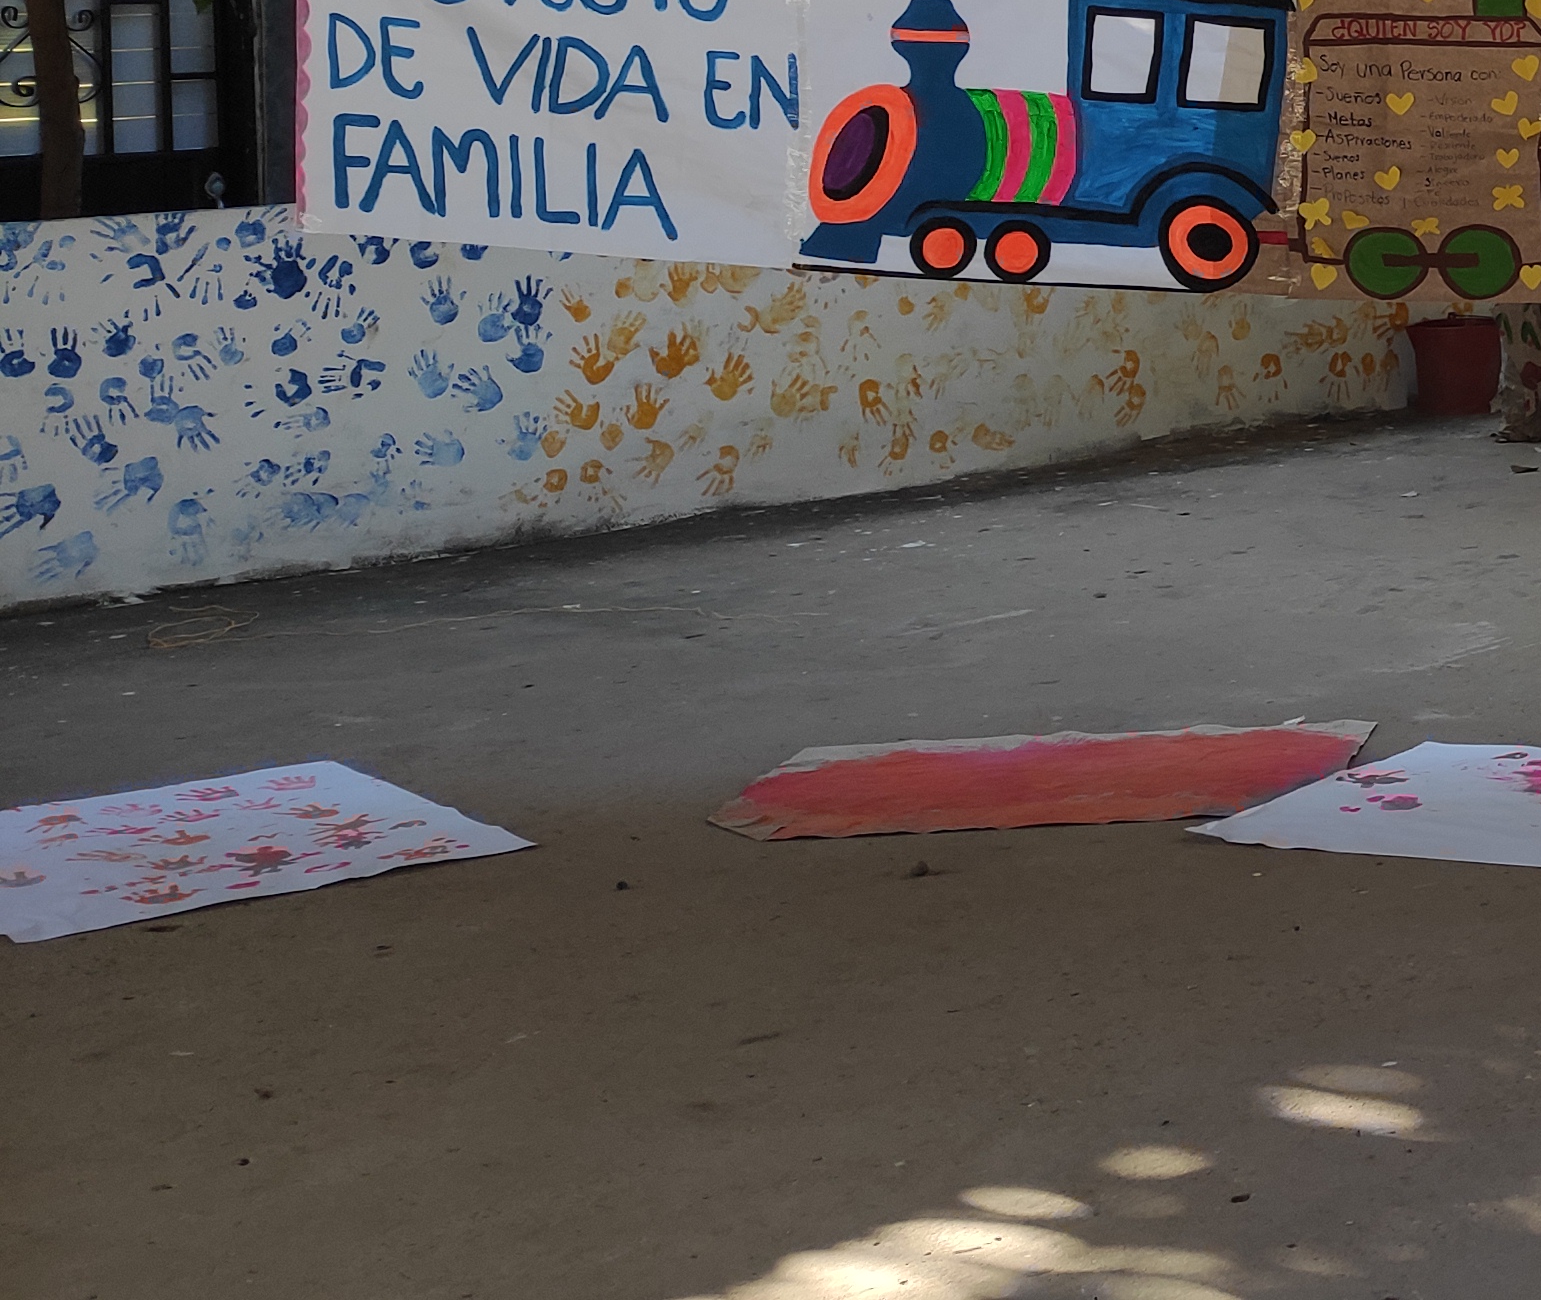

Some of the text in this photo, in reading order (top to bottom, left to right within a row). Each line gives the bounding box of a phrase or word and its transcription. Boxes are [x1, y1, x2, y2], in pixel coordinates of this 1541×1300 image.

[1332, 19, 1527, 42] ¿QUIEN SOY YO?
[328, 13, 800, 130] DE VIDA EN
[1320, 54, 1346, 79] Soy
[1356, 63, 1393, 78] una
[1400, 60, 1463, 82] Persona
[333, 113, 679, 241] FAMILIA
